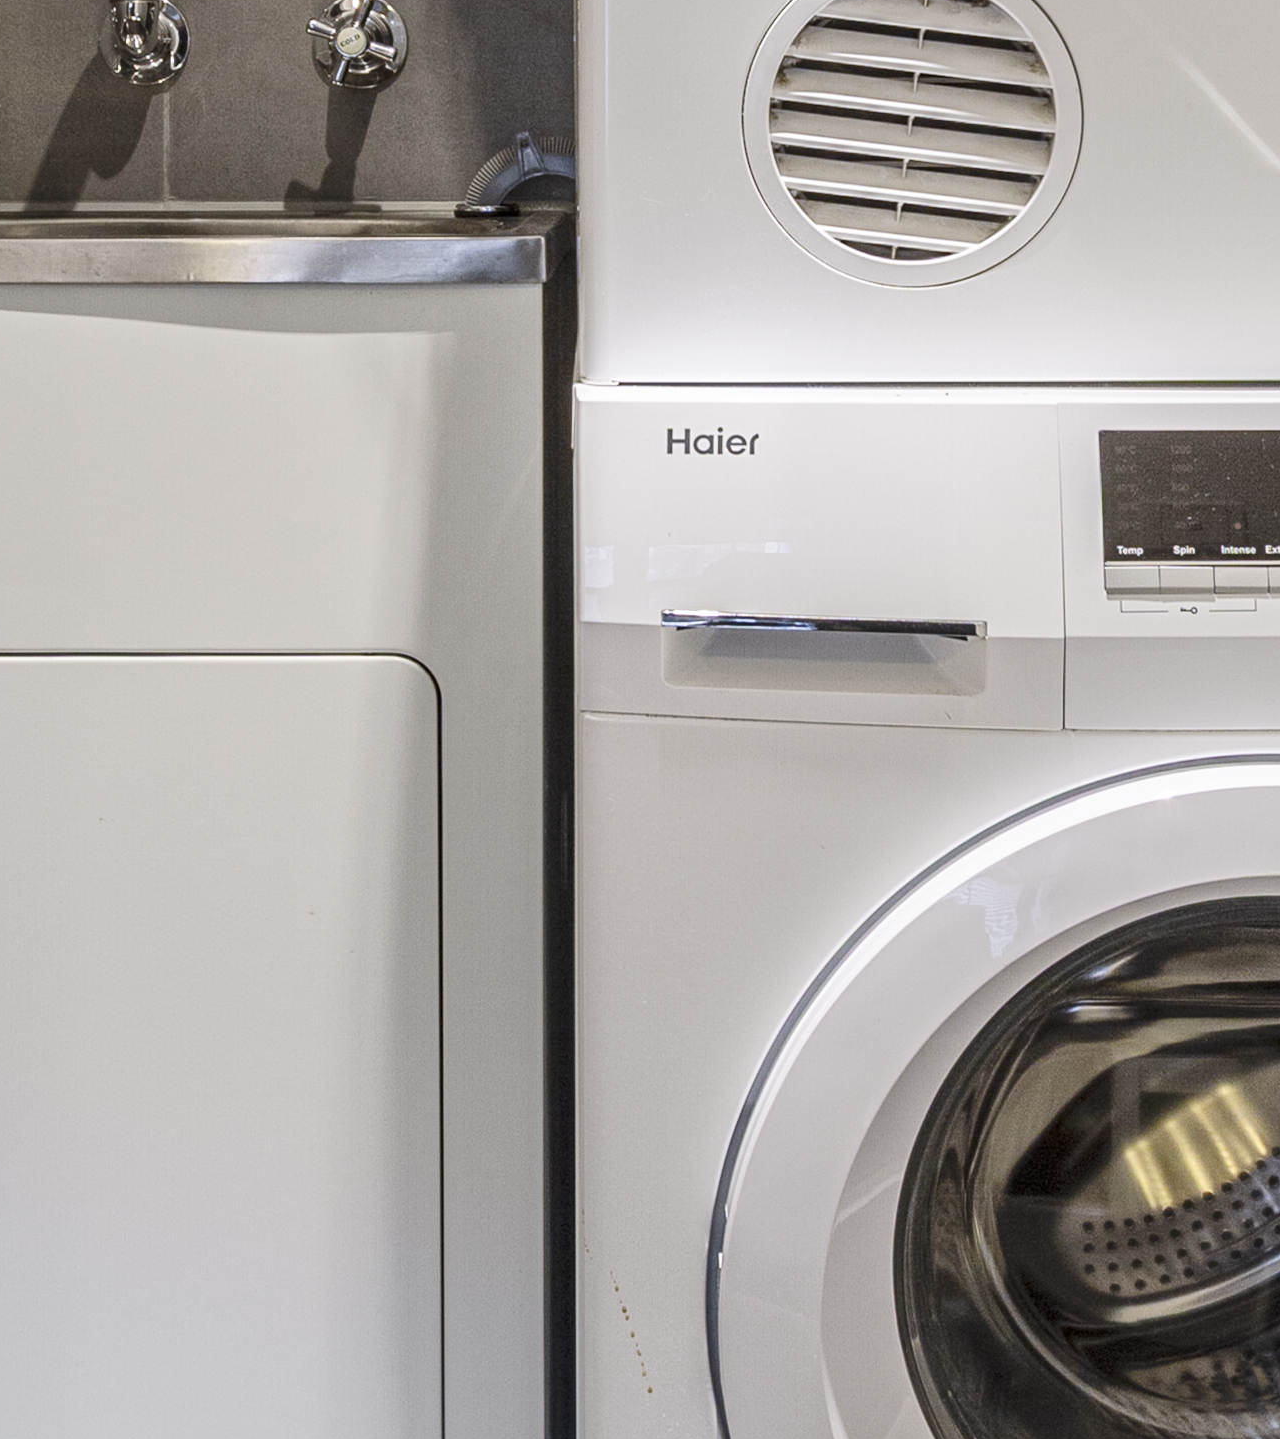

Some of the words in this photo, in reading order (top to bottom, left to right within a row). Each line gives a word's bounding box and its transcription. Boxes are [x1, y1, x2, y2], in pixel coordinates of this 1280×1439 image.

[340, 33, 360, 47] COLD
[666, 427, 759, 455] Haier
[1117, 545, 1144, 557] Temp
[1173, 544, 1196, 556] Spin
[1221, 545, 1256, 554] Intense
